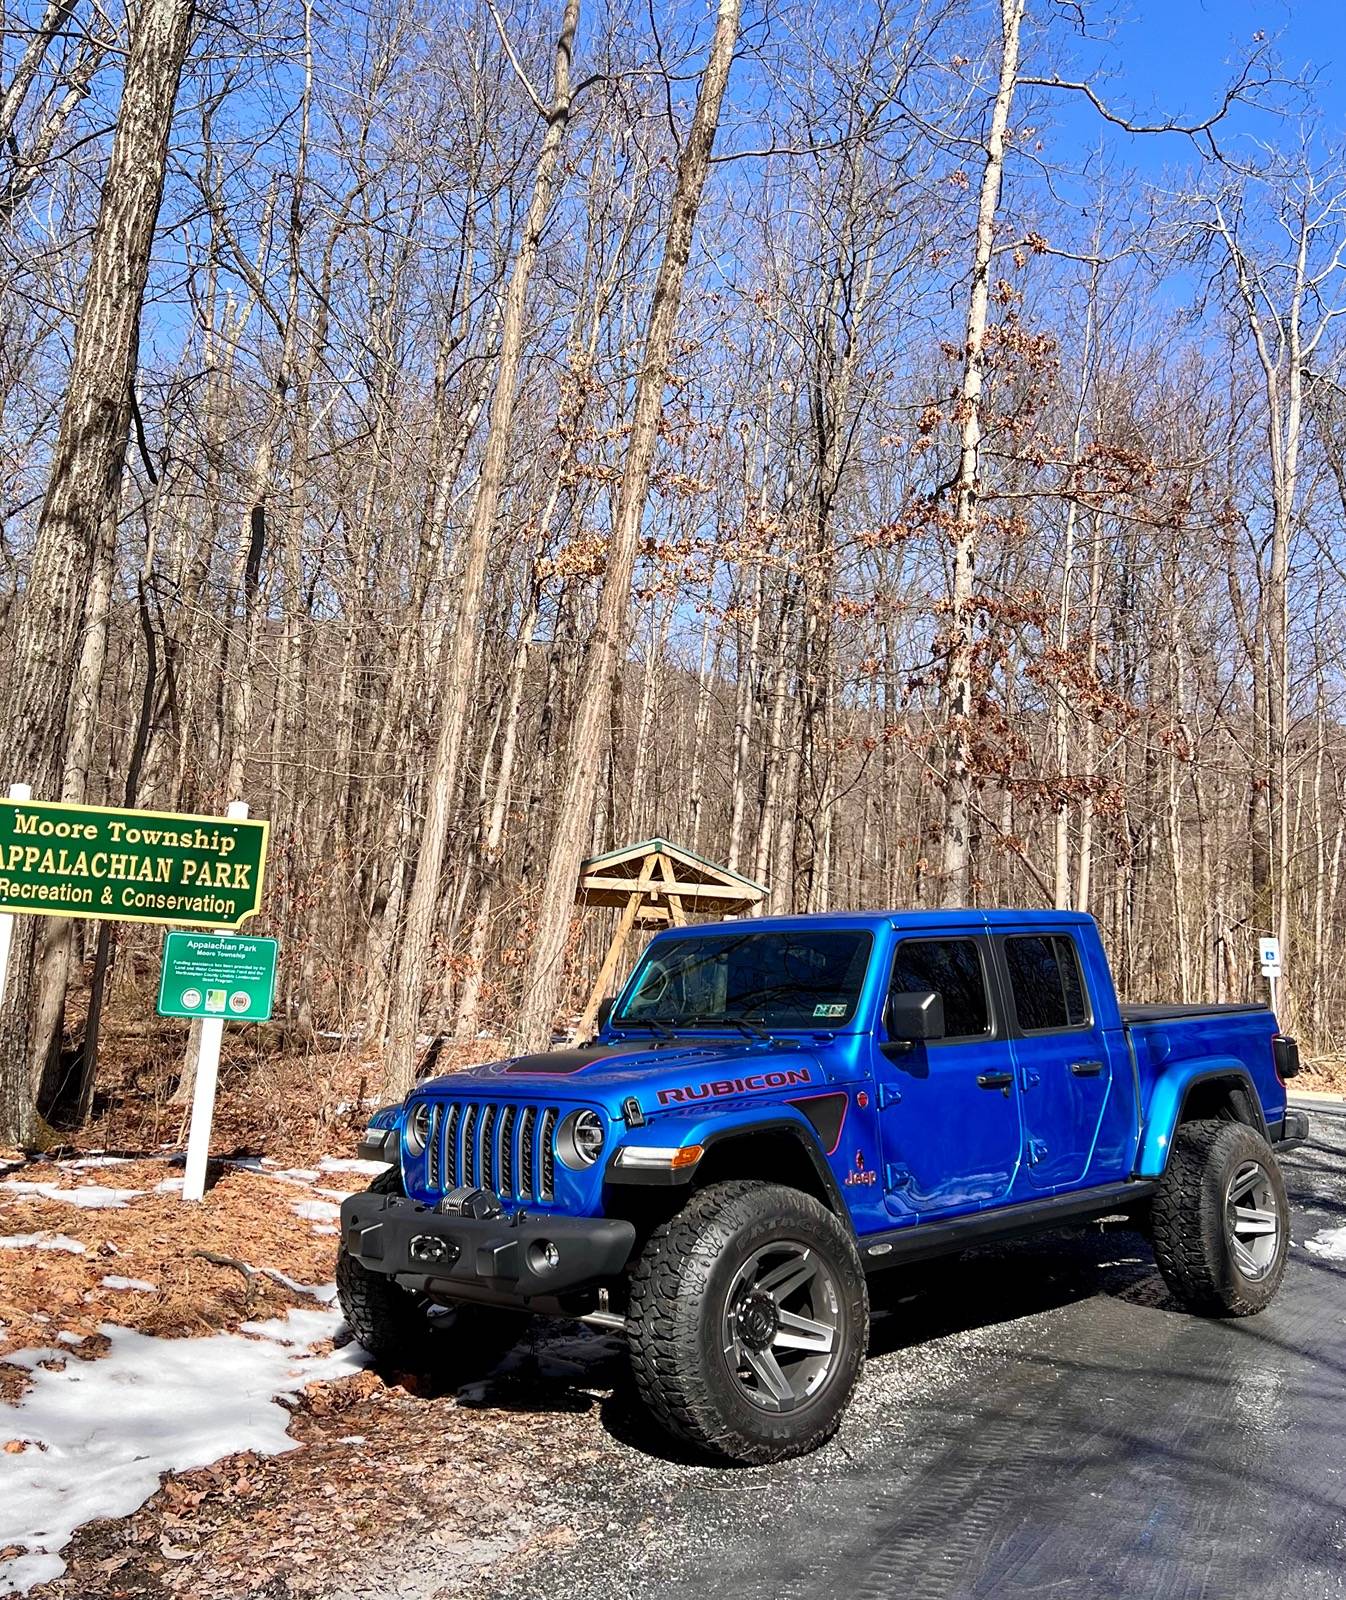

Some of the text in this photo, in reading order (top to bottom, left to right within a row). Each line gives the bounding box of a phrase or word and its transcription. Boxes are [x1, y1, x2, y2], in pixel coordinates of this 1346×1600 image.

[13, 813, 236, 857] Moore Township
[180, 859, 252, 890] PARK
[0, 877, 236, 915] Recreation & Conservation
[187, 940, 257, 952] Appalachian Park
[217, 951, 246, 959] Township
[655, 1068, 812, 1106] RUBICON
[844, 1169, 877, 1187] Jeep
